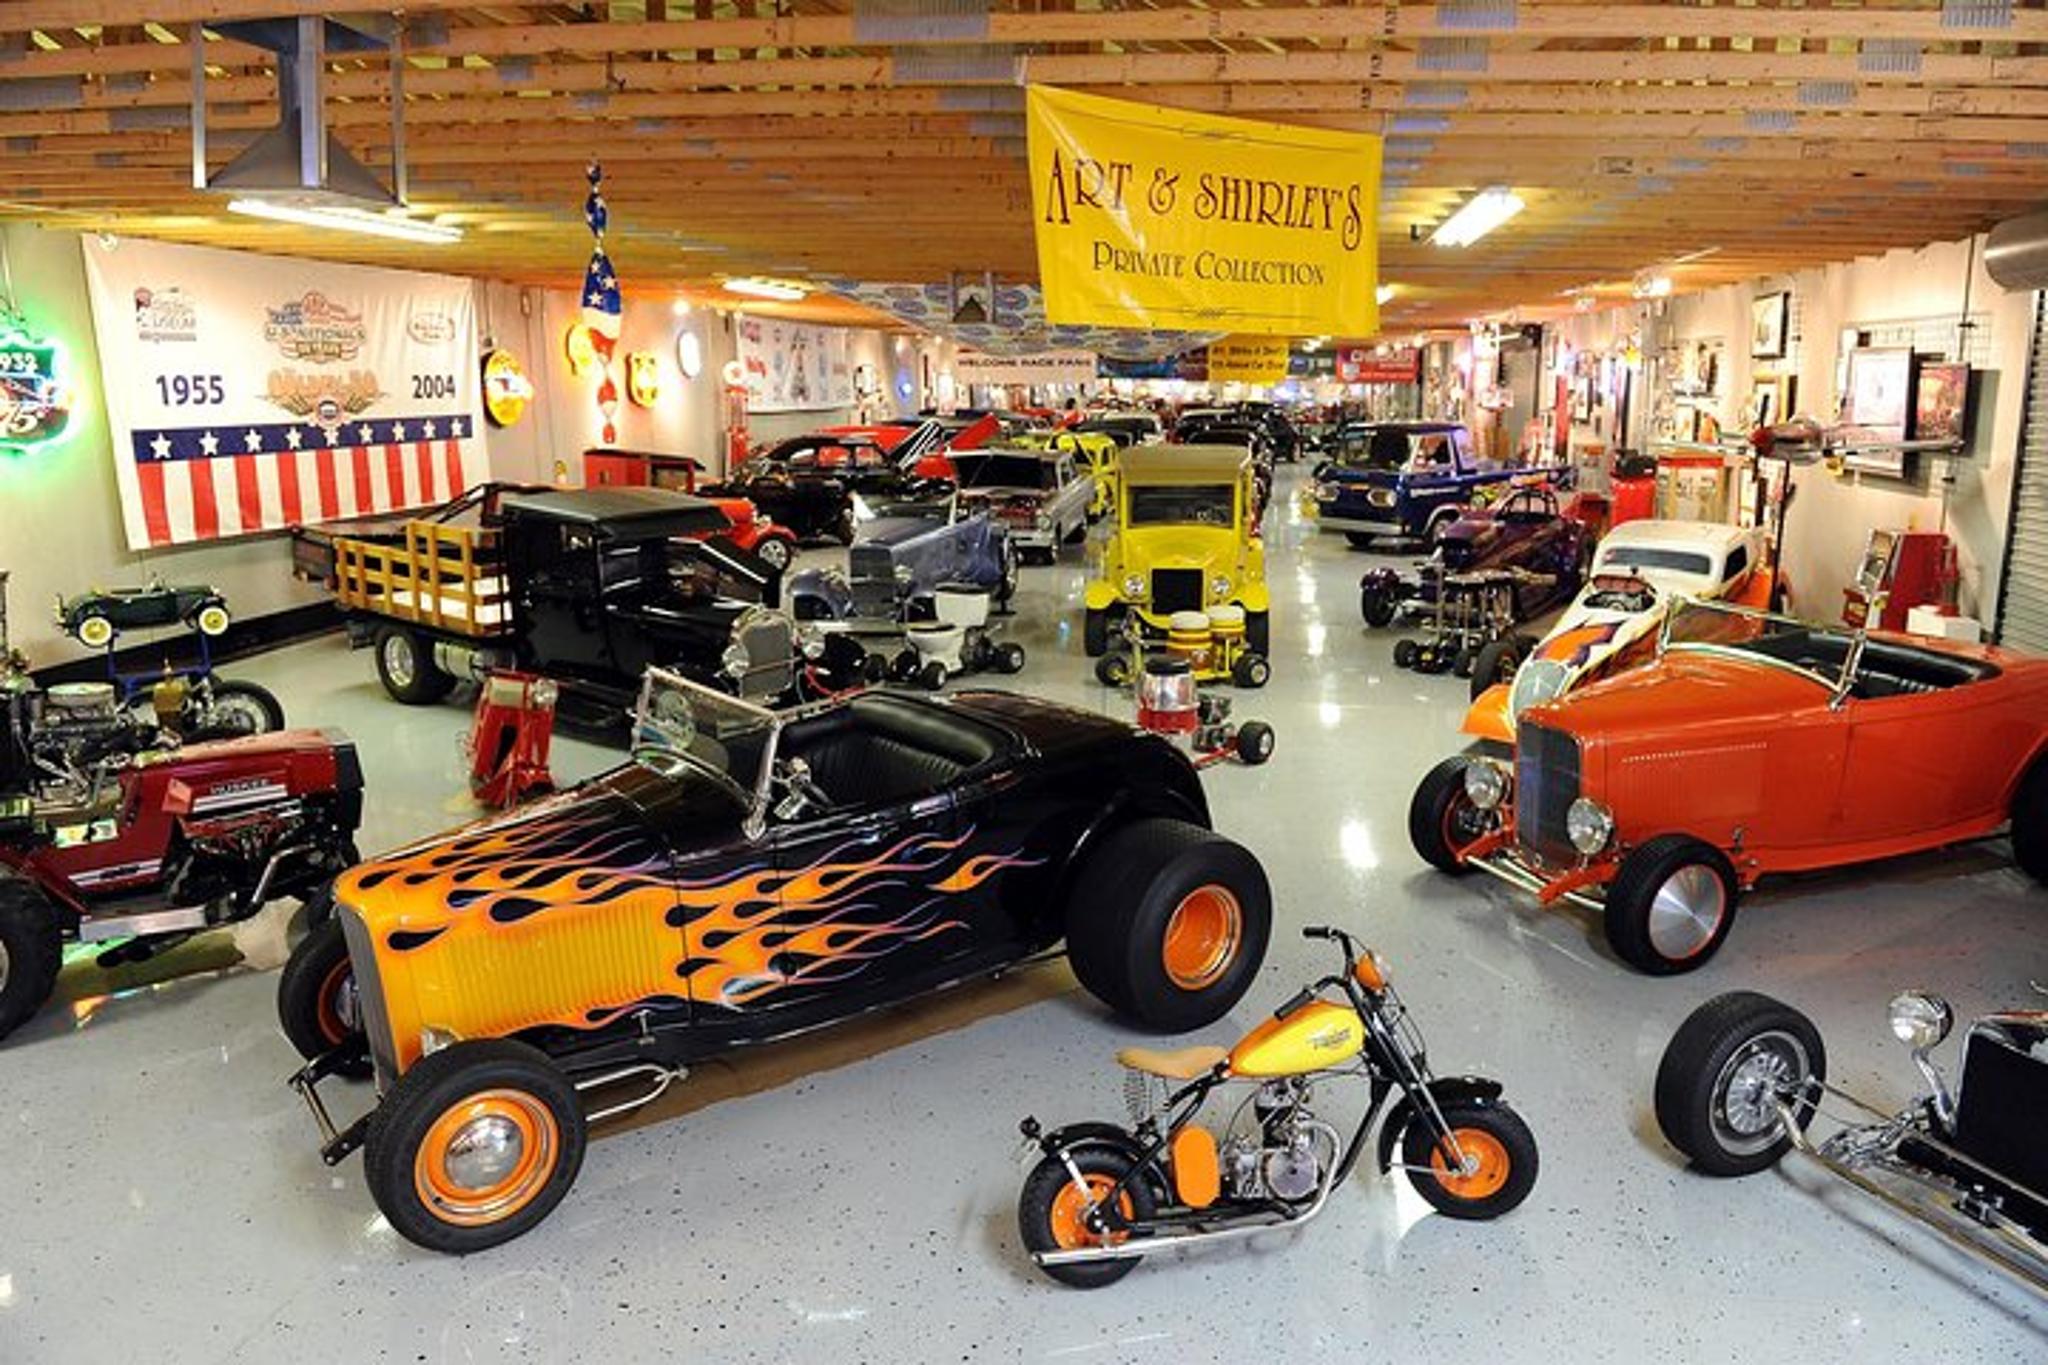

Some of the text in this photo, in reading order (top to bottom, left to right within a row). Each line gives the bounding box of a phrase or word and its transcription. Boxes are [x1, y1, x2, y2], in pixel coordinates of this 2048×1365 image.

[1045, 148, 1363, 251] ART & SHIRLEY'S
[1093, 241, 1325, 286] PRIVATE COLLECTION
[958, 357, 1017, 367] WELCOME
[156, 375, 225, 406] 1955
[412, 374, 456, 399] 2004
